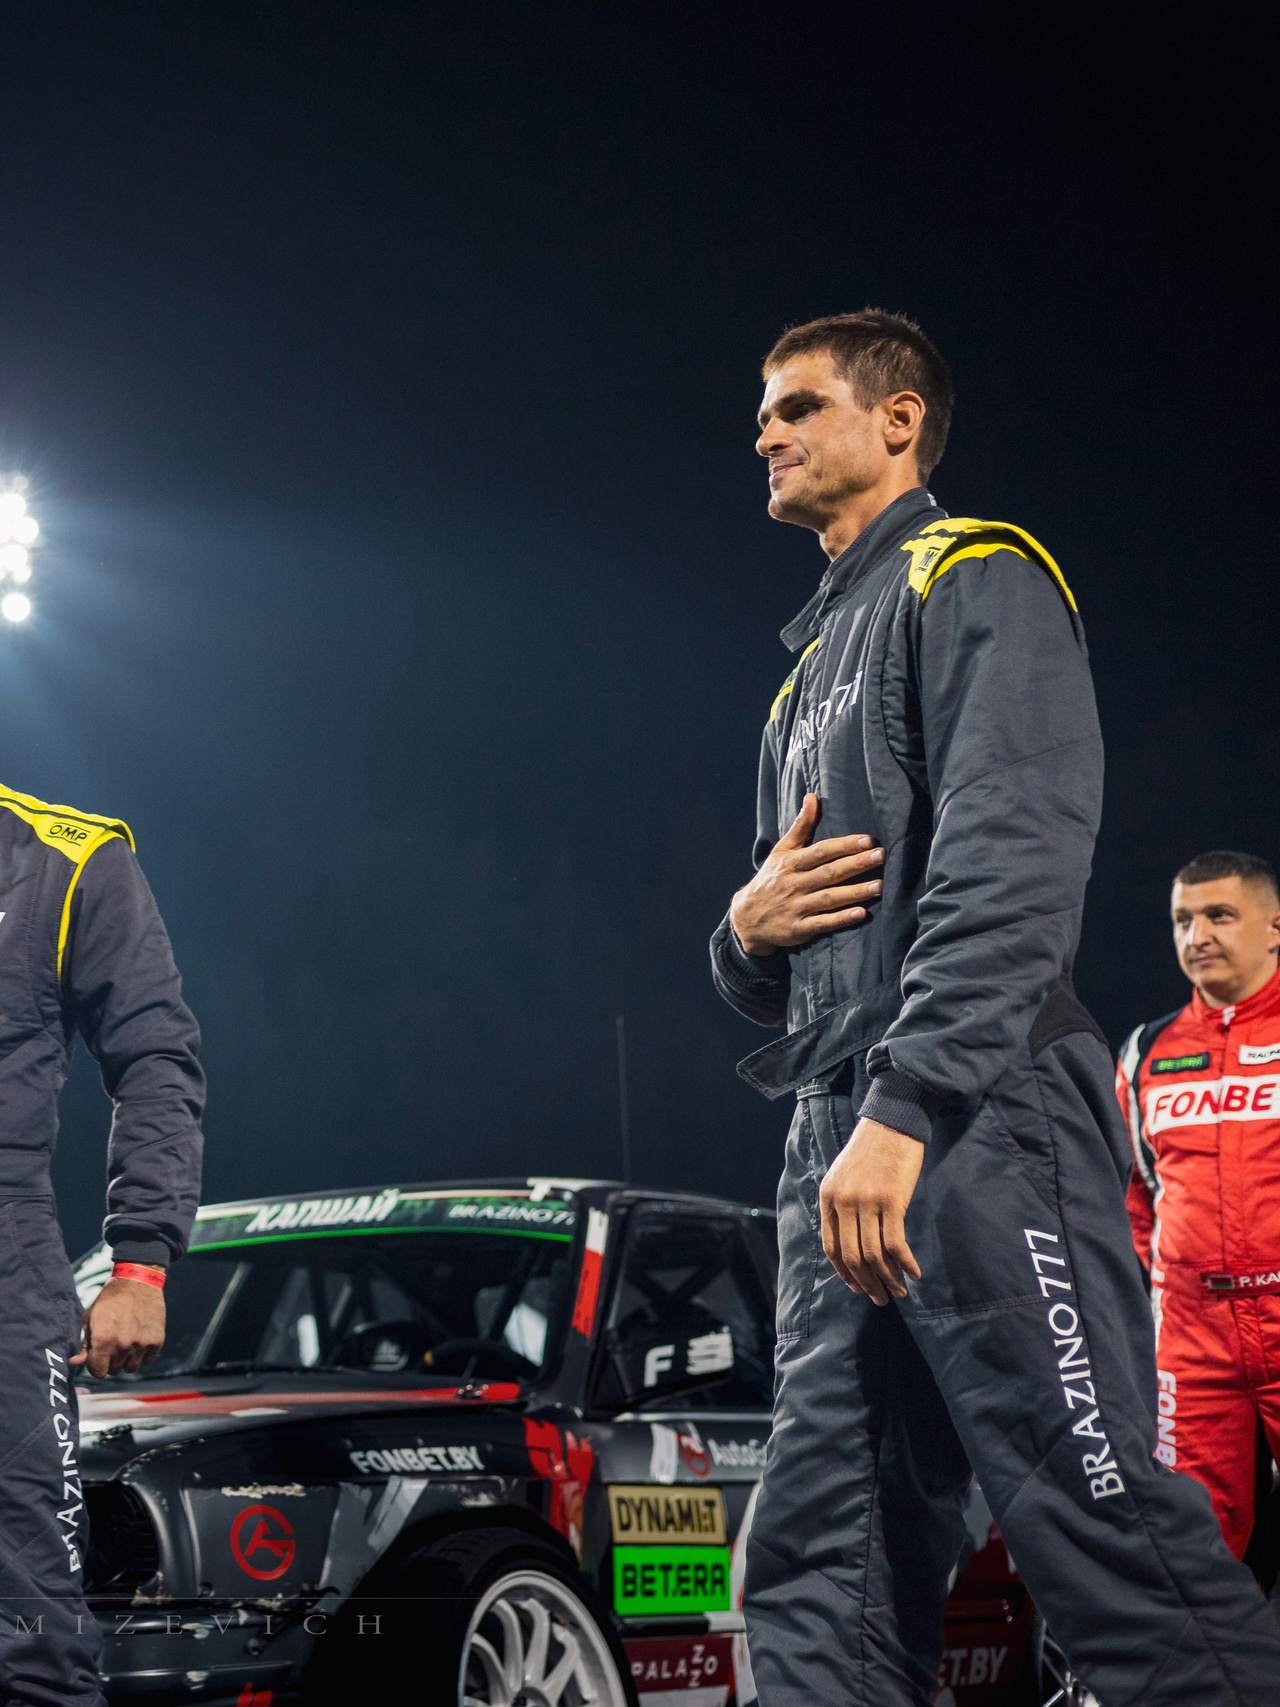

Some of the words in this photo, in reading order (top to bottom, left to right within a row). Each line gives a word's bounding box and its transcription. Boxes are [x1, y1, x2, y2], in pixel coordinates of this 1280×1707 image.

[50, 824, 88, 841] OMP
[1153, 1082, 1280, 1124] FONBE
[1255, 1270, 1280, 1286] KA
[1155, 1368, 1177, 1472] FONB
[349, 1445, 486, 1474] FONBET.BY
